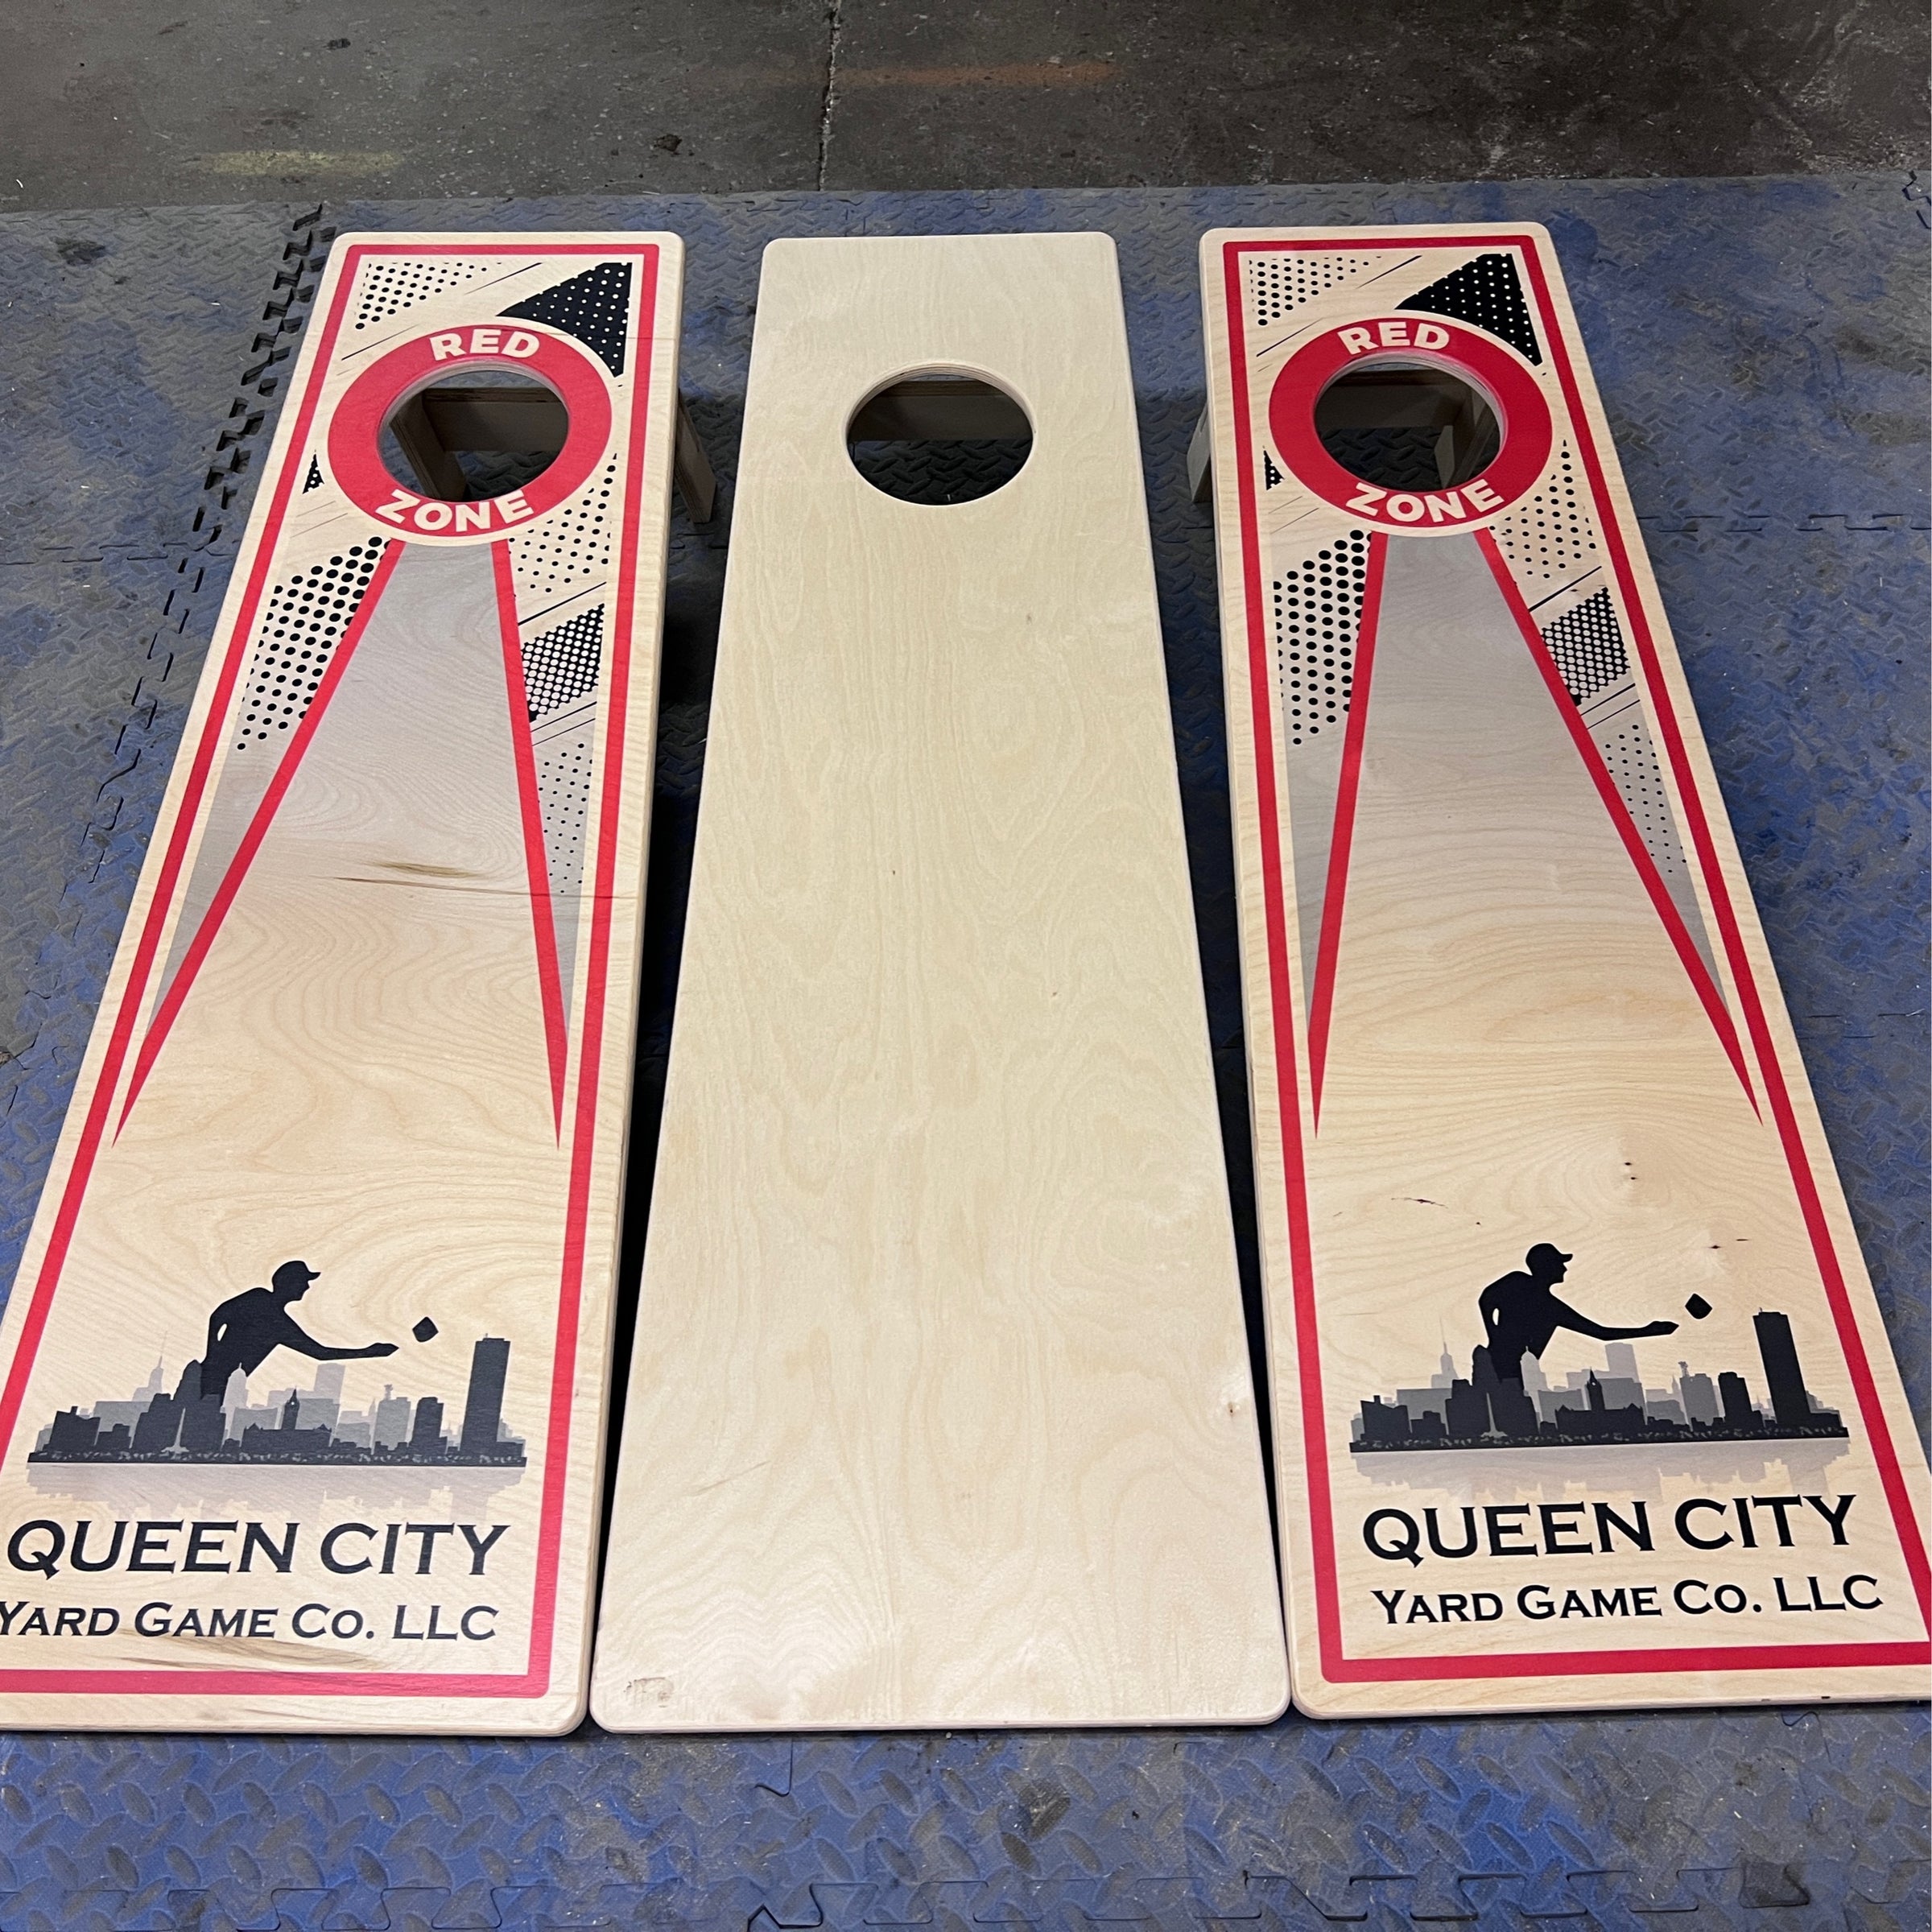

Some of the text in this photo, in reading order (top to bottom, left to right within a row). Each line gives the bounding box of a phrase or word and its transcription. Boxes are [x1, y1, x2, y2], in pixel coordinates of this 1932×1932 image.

[429, 328, 540, 361] RED
[1337, 321, 1450, 355] RED
[375, 489, 535, 532] ZONE
[1345, 479, 1505, 522] ZONE
[7, 1519, 510, 1580] QUEEN CITY
[1363, 1494, 1857, 1568] QUEEN CITY
[1370, 1574, 1885, 1624] YARD GAME CO. LLC
[0, 1601, 499, 1641] YARD GAME CO. LLC
